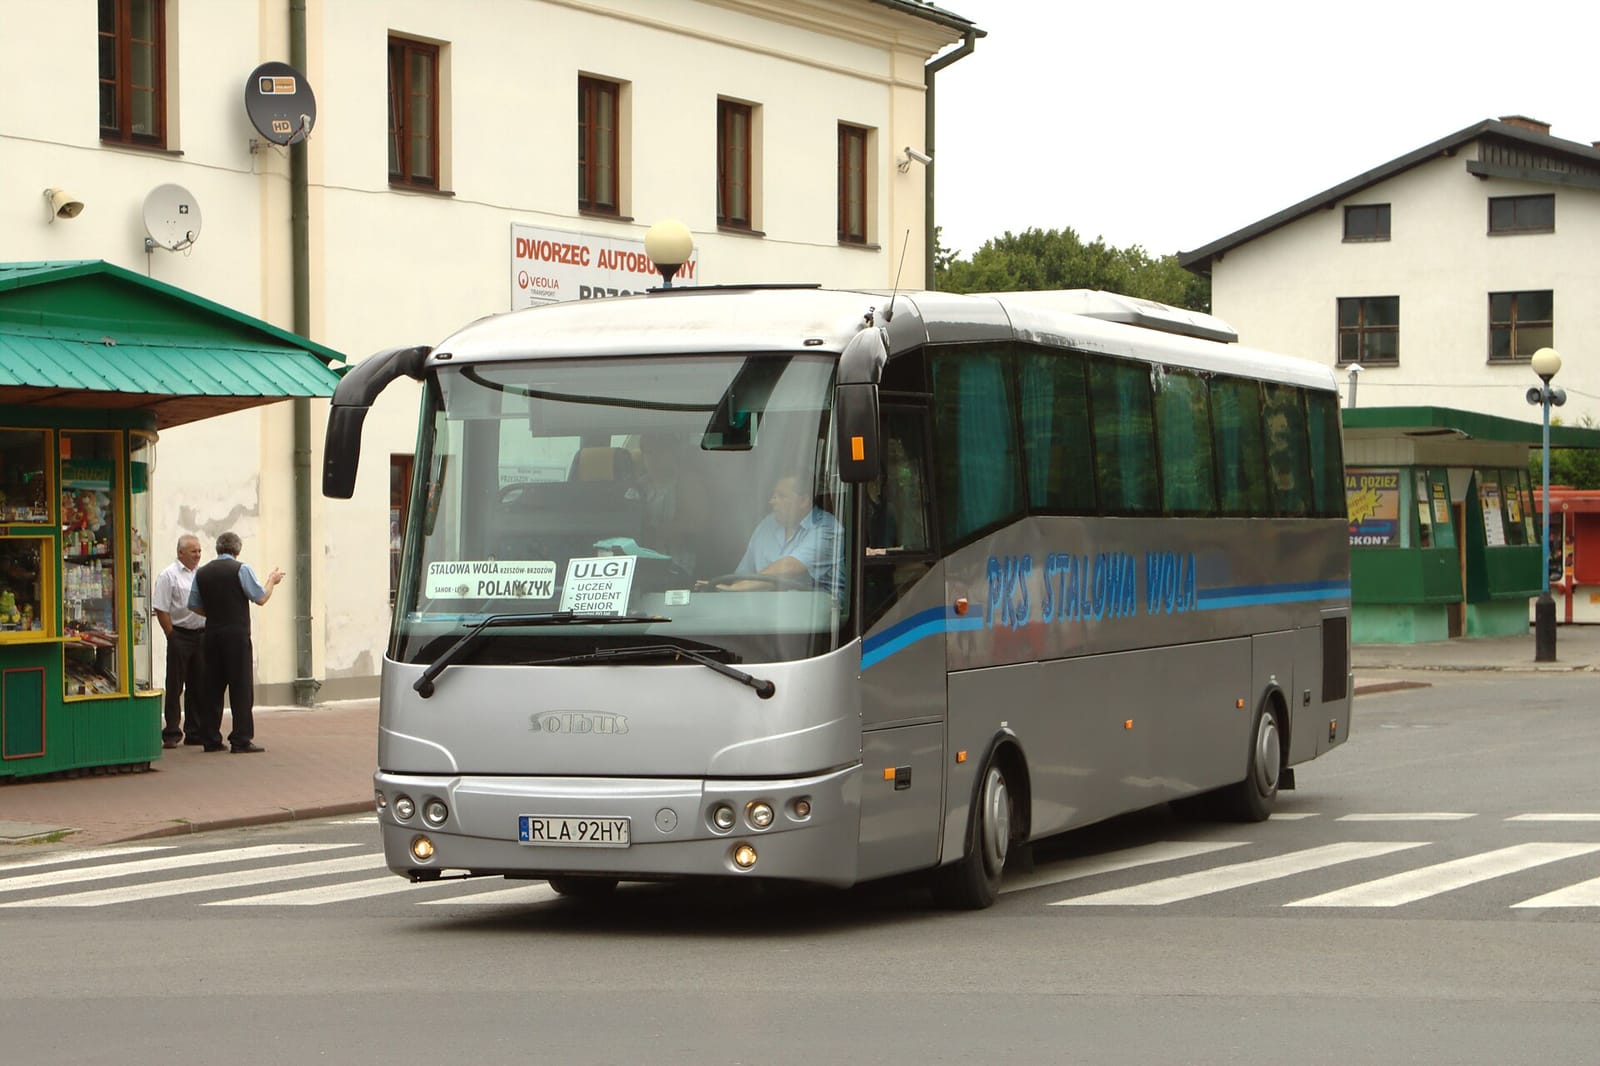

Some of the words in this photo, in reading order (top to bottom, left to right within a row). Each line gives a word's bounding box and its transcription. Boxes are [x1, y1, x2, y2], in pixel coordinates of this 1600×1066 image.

[274, 122, 290, 131] HD
[516, 237, 590, 267] DWORZEC
[530, 276, 560, 290] VEOLIA
[430, 563, 471, 575] STALOWA
[473, 563, 499, 574] WOLA
[574, 562, 628, 578] ULGI
[477, 579, 552, 597] POLAŃCZYK
[577, 581, 613, 591] UCZEŃ
[986, 553, 1033, 632] PKS
[1042, 551, 1137, 624] STALOWA
[1146, 551, 1198, 615] WOLA
[575, 592, 621, 601] STUDENT
[573, 602, 613, 611] SENIOR
[532, 820, 571, 840] RLA
[577, 821, 624, 841] 92HY
